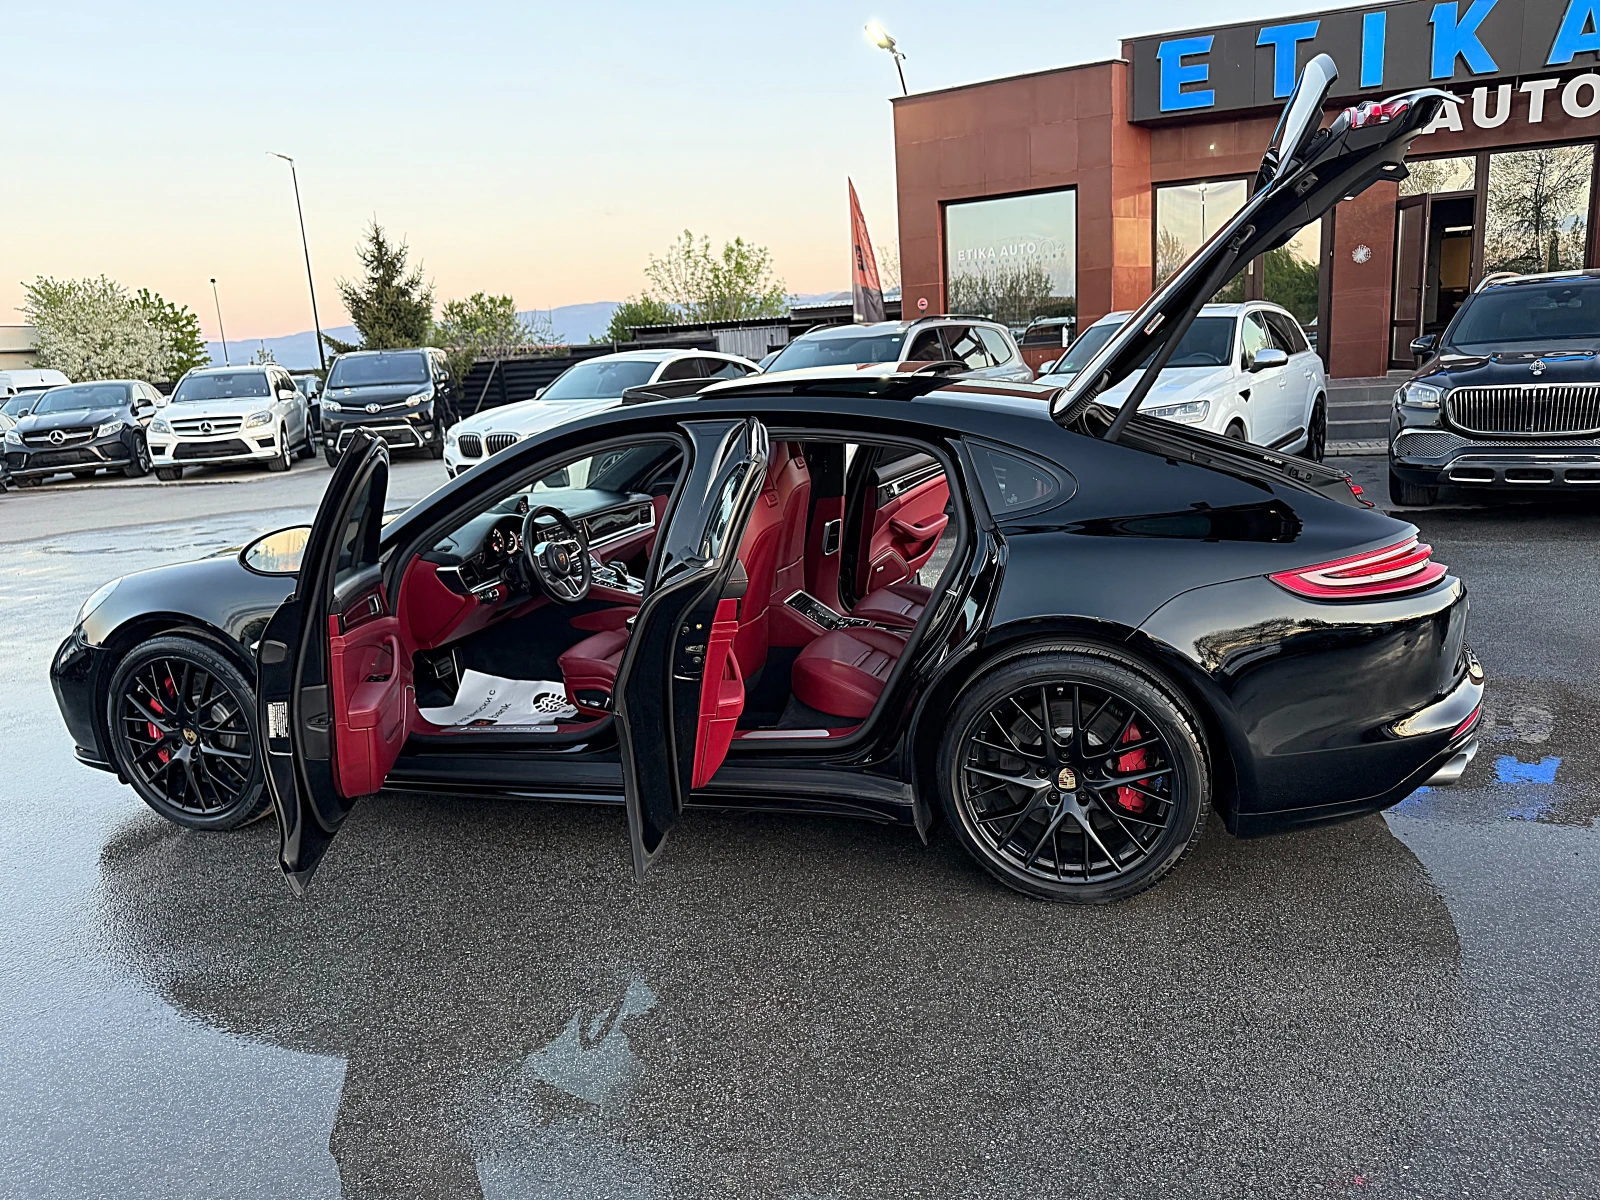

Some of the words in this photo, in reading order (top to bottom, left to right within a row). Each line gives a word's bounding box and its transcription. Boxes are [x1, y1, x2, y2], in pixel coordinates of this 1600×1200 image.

[1157, 0, 1600, 112] ETIKA
[1422, 73, 1600, 134] AUTO
[957, 246, 996, 261] ETIKA
[1000, 242, 1037, 257] AUTO
